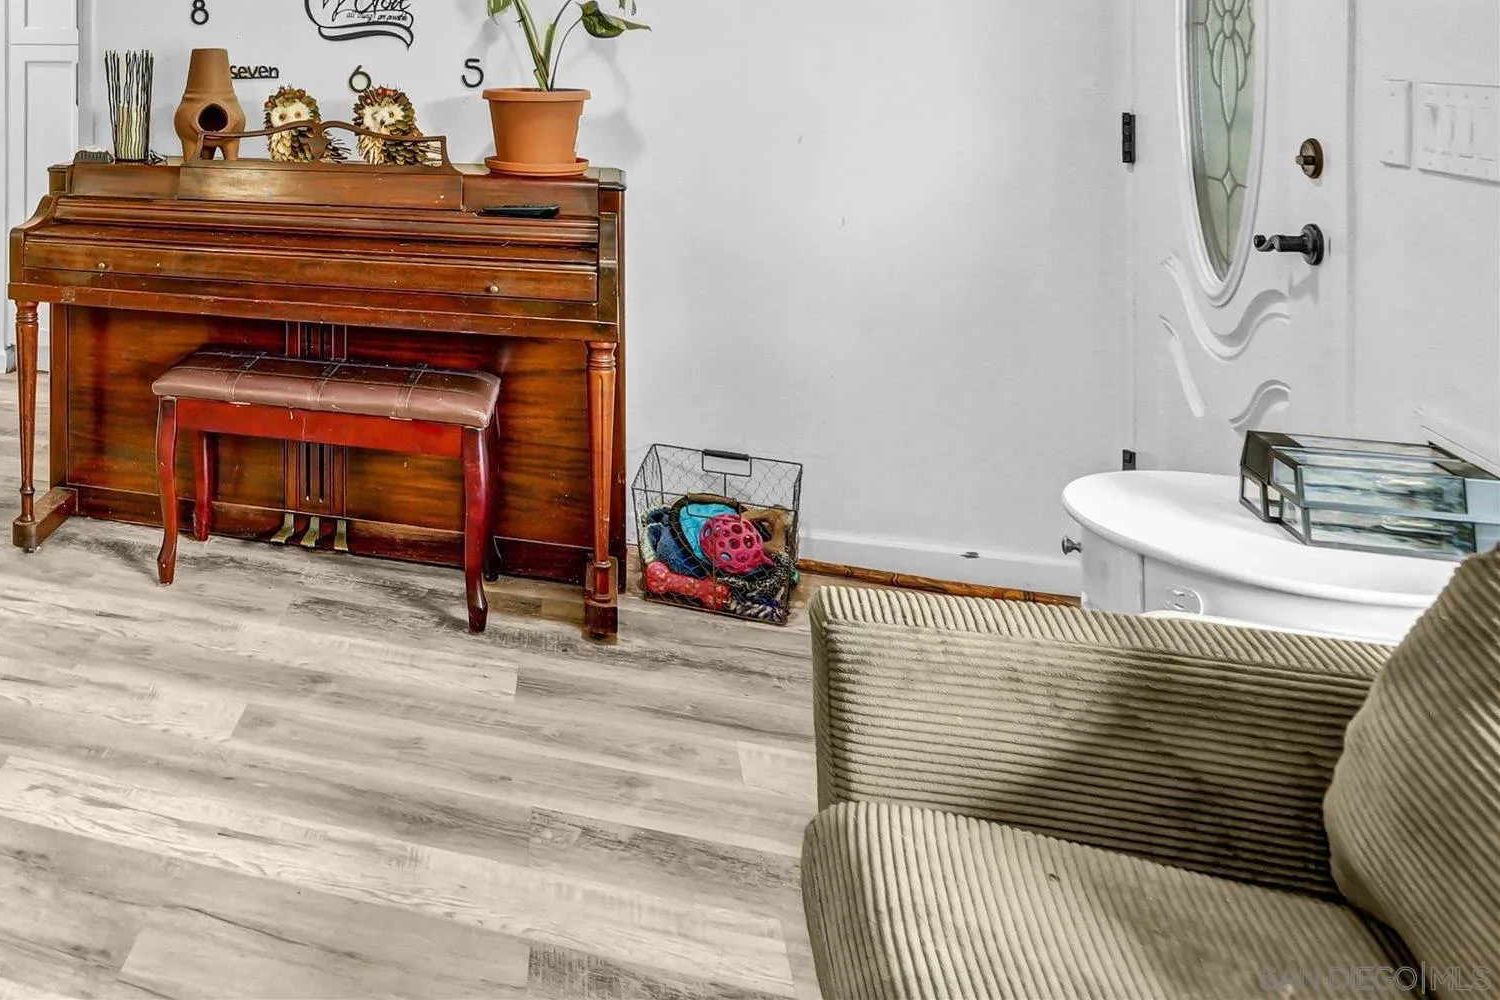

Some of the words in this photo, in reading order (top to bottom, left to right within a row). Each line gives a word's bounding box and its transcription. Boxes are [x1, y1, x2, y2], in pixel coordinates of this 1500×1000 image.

[229, 65, 280, 80] seven
[348, 64, 372, 94] 6
[461, 58, 485, 89] 5
